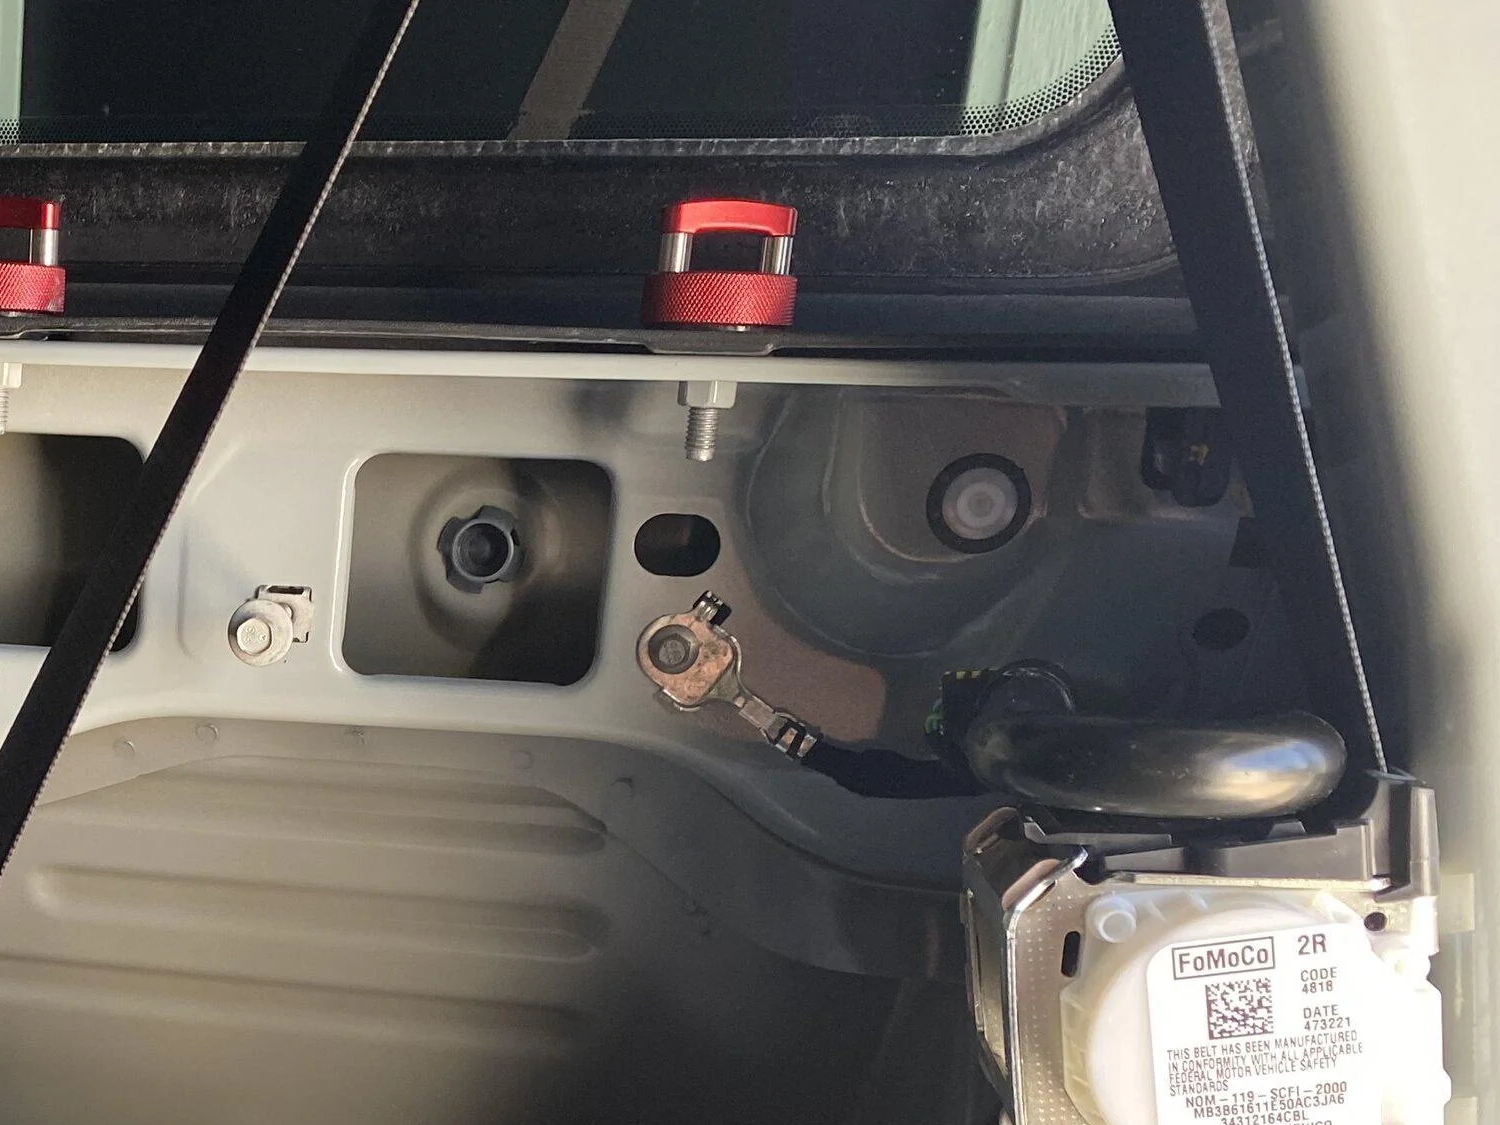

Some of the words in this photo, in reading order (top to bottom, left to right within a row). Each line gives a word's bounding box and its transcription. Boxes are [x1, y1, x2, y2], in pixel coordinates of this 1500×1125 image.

[1178, 945, 1269, 974] FoMoCo
[1297, 933, 1328, 956] 2R
[1300, 967, 1338, 982] CODE
[1303, 1005, 1339, 1019] DATE
[1304, 1016, 1351, 1032] 473221
[1167, 1047, 1190, 1061] THIS
[1194, 1045, 1217, 1058] BELT
[1221, 1042, 1241, 1055] HAS
[1245, 1040, 1270, 1053] BEEN
[1275, 1030, 1357, 1049] MANUFACTURED
[1168, 1061, 1178, 1073] IN
[1182, 1055, 1246, 1073] CONFORMITY
[1251, 1052, 1277, 1066] WITH
[1281, 1050, 1299, 1061] ALL
[1303, 1042, 1363, 1060] APPLICABLE
[1169, 1070, 1212, 1085] FEDERAL
[1216, 1066, 1252, 1080] MOTOR
[1255, 1060, 1297, 1076] VEHICLE
[1300, 1056, 1338, 1071] SAFETY
[1169, 1079, 1229, 1097] STANDARDS
[1186, 1094, 1216, 1108] NOM
[1232, 1090, 1255, 1104] 119
[1270, 1086, 1300, 1100] SCFI
[1316, 1081, 1348, 1095] 2000
